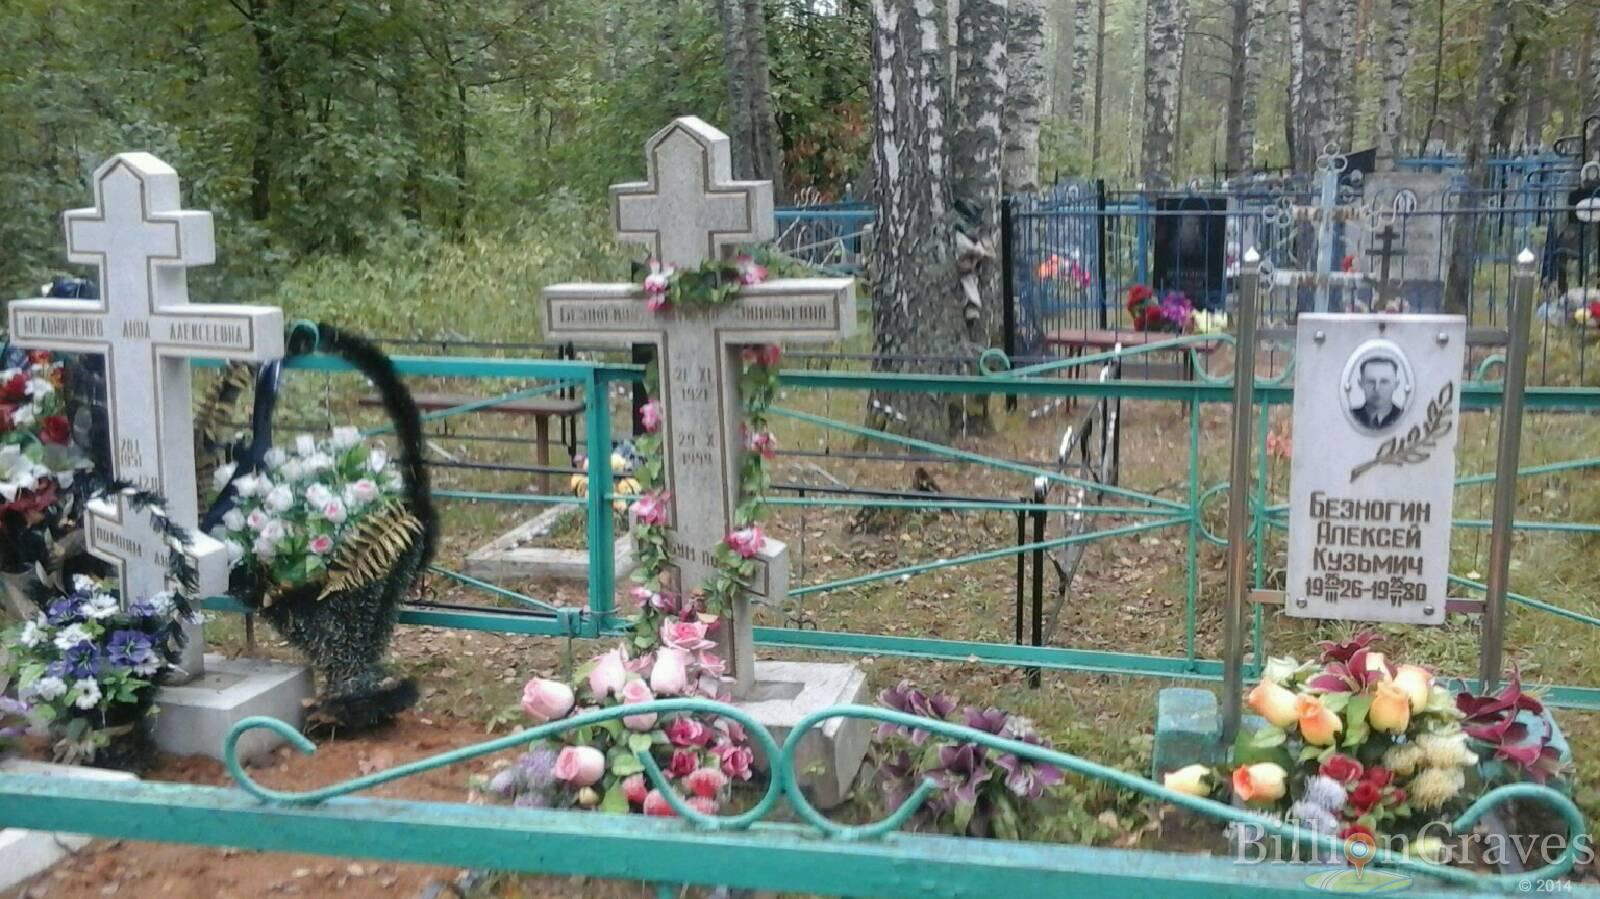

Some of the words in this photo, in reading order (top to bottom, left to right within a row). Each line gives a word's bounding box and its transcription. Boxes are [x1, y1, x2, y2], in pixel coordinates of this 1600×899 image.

[24, 315, 104, 338] МЕЛЬНИЧЕНКО
[122, 319, 151, 340] АННА
[169, 320, 243, 345] АЛЕКСЕЕВНА
